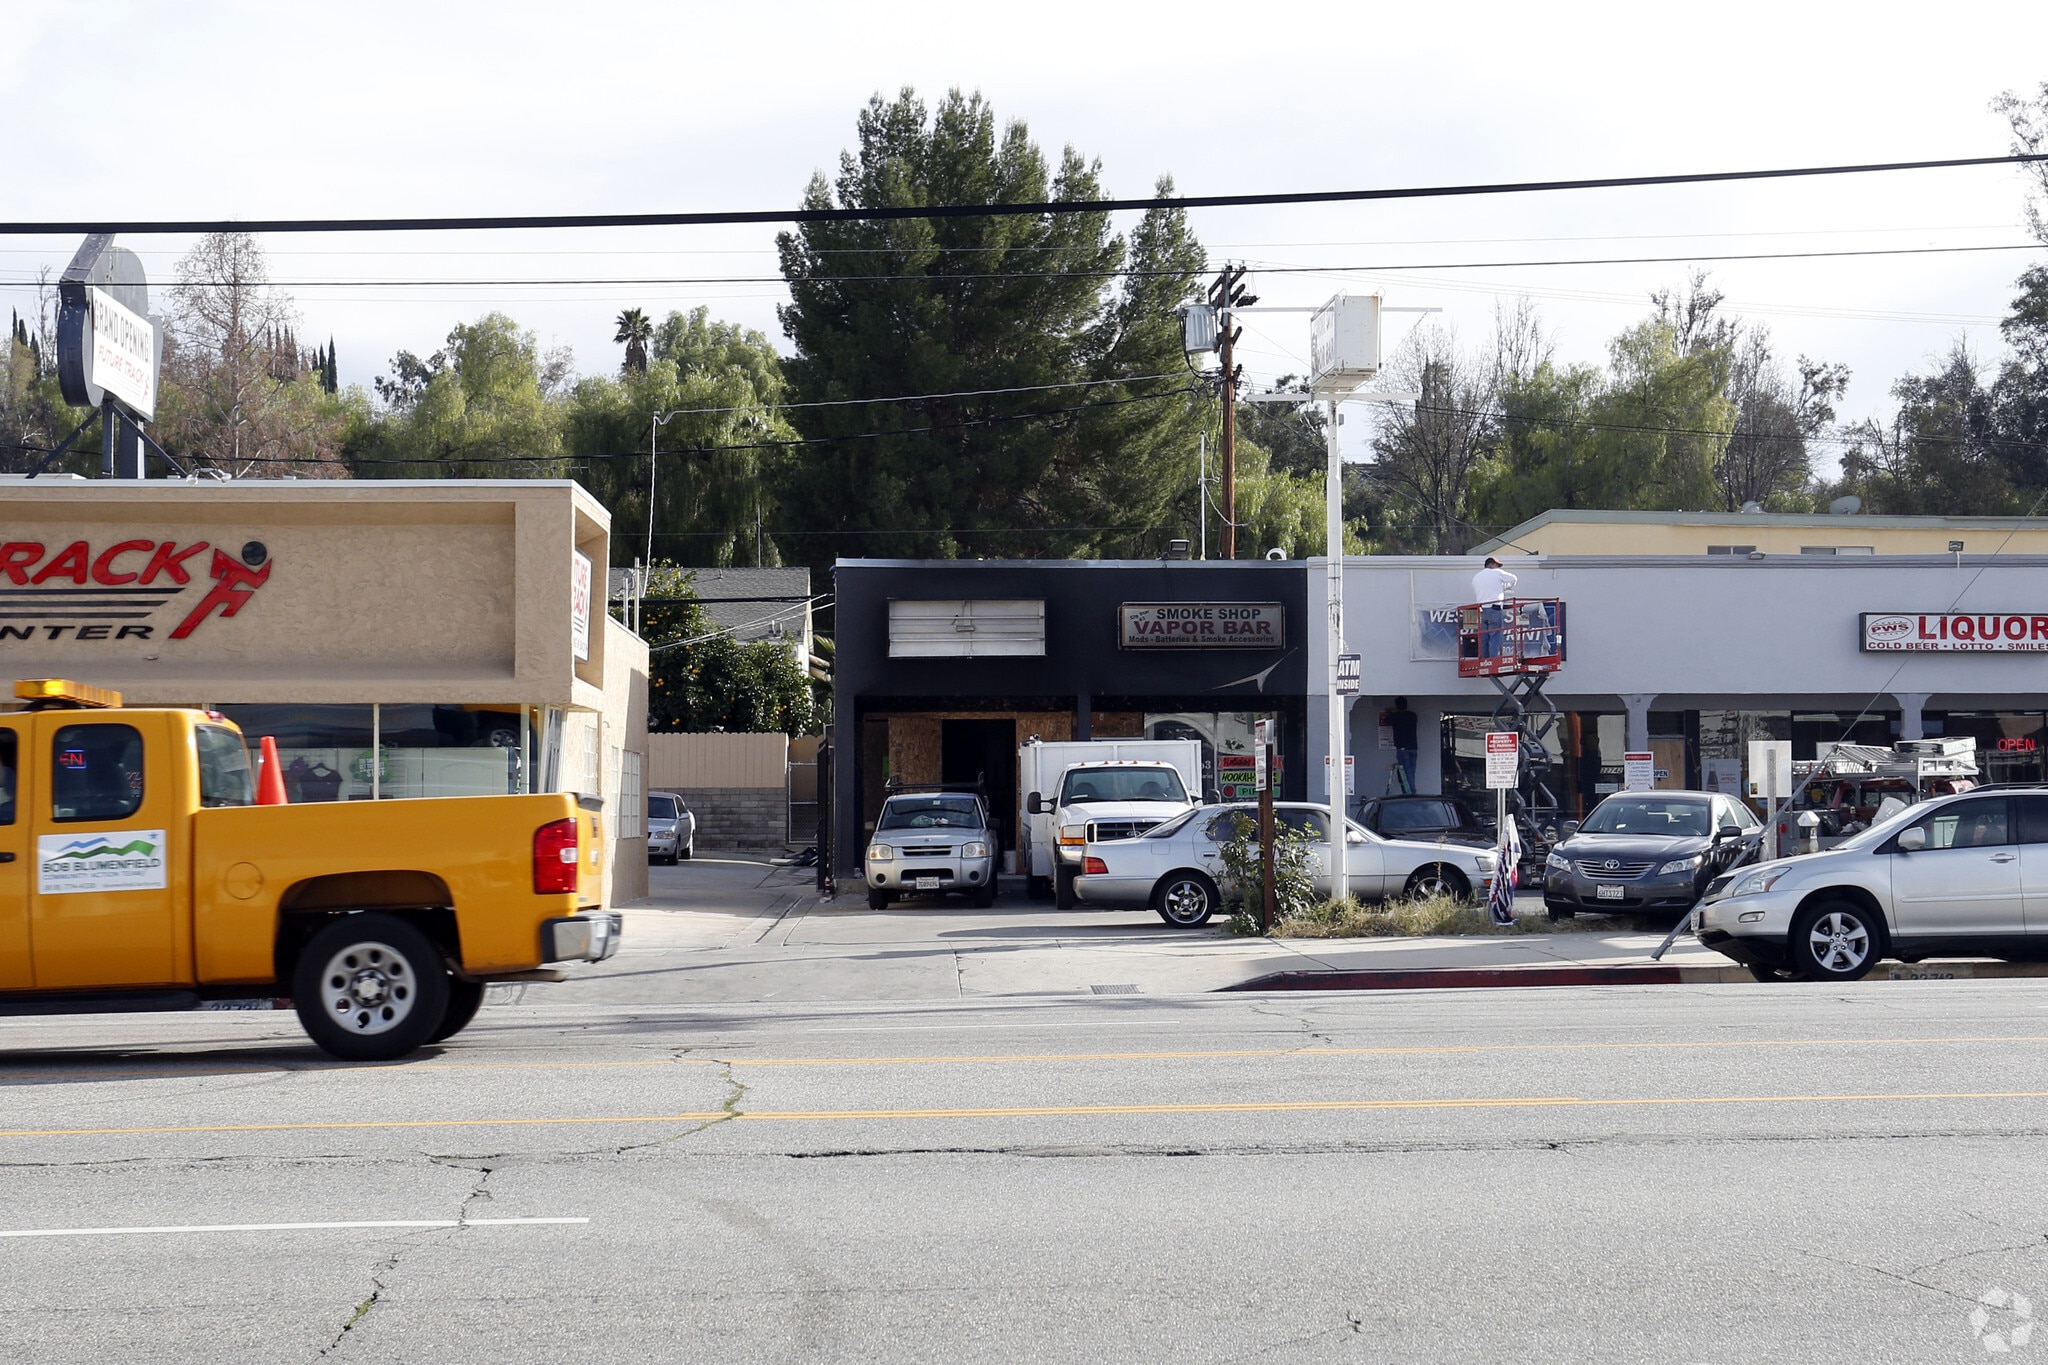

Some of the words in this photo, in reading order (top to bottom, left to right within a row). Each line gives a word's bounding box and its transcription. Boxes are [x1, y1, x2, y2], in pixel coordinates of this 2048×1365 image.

[94, 298, 119, 344] GRAND
[98, 344, 123, 372] FUTURE
[124, 360, 145, 384] TRACK
[0, 540, 210, 586] RACK
[1156, 608, 1213, 620] SMOKE
[1218, 608, 1261, 620] SHOP
[1430, 610, 1464, 623] WES
[1133, 620, 1215, 635] VAPOR
[1223, 620, 1272, 635] BAR
[1871, 624, 1910, 634] PWS
[1918, 616, 2048, 642] LIQUOR
[1868, 642, 1902, 650] COLD
[1906, 642, 1939, 650] BEER
[1953, 642, 1994, 650] LOTTO
[2007, 642, 2048, 650] SMILES
[1338, 659, 1360, 677] ATM
[1336, 679, 1360, 690] INSIDE
[1998, 738, 2035, 751] OPEN
[42, 863, 70, 872] BOB
[74, 859, 160, 871] BLUMENFIELD
